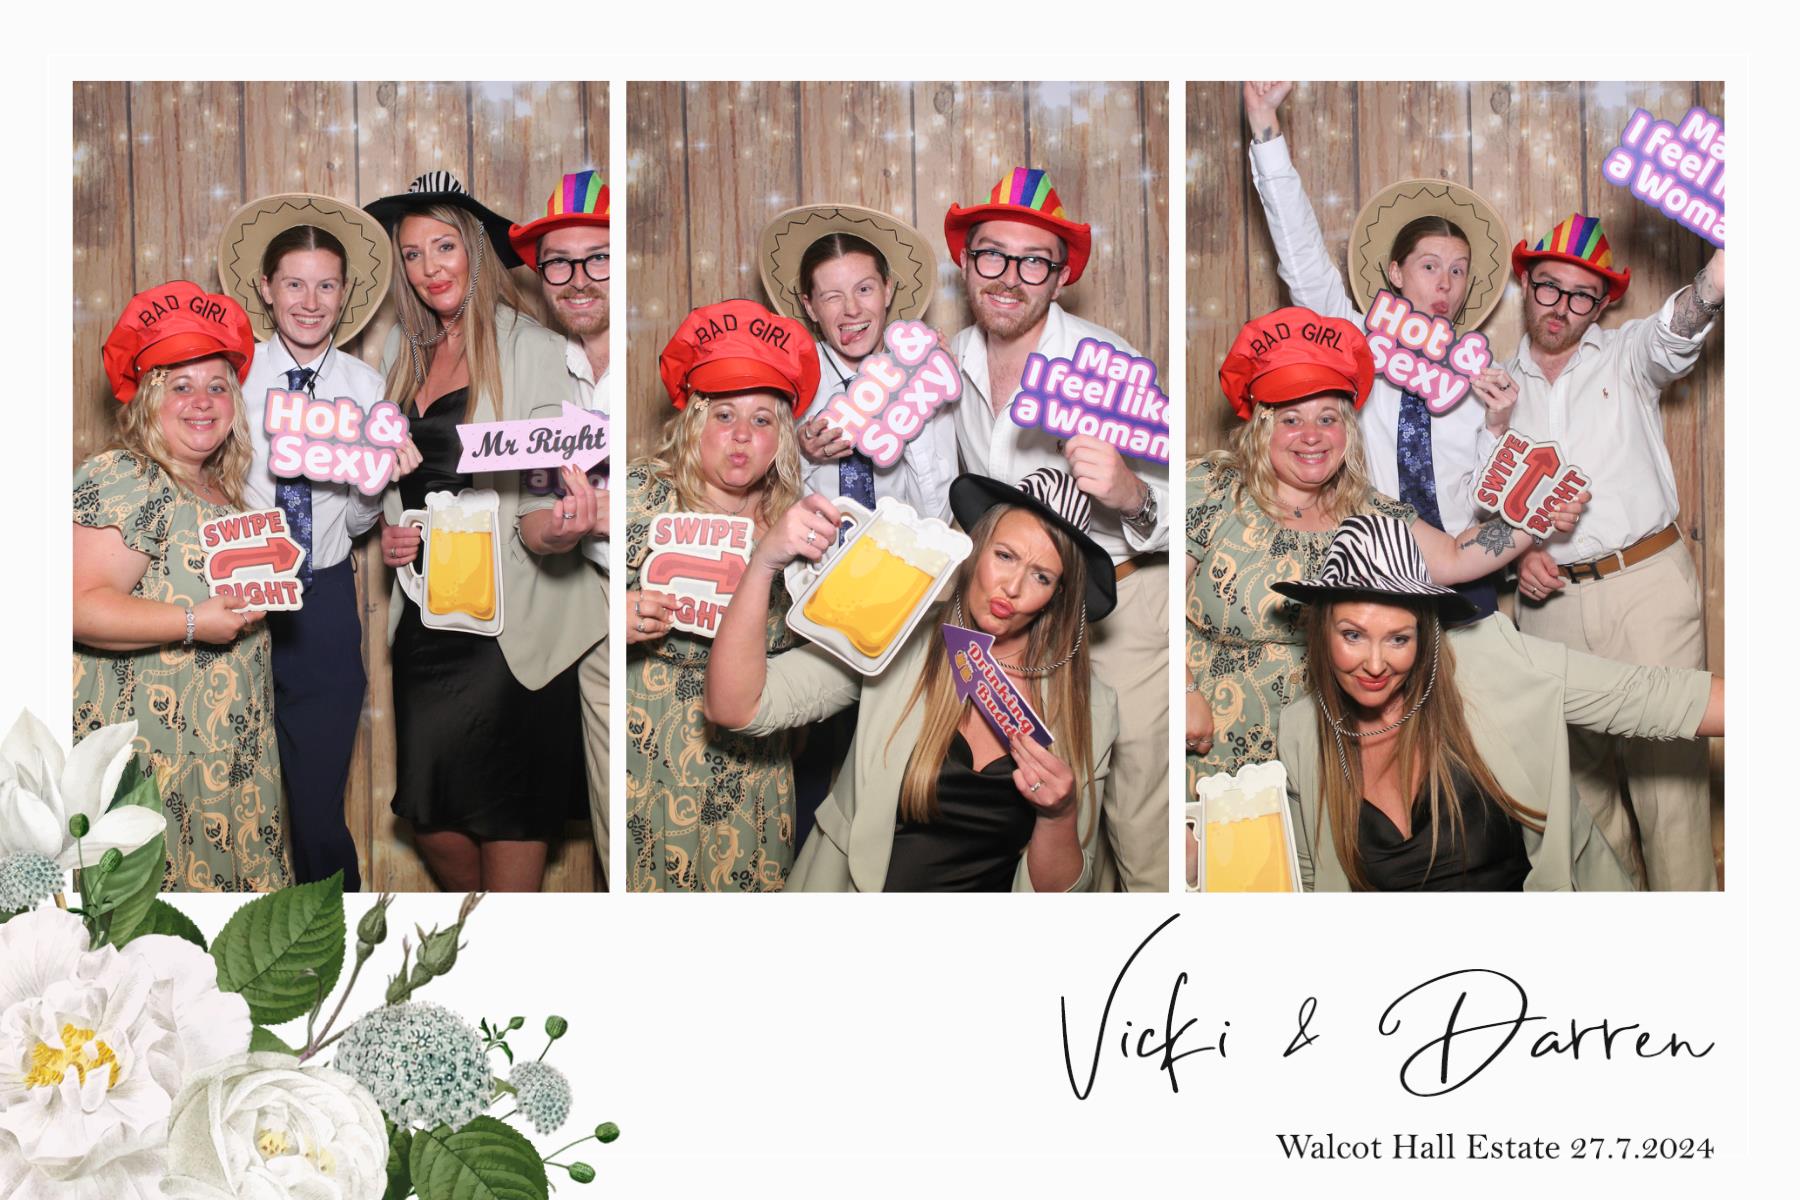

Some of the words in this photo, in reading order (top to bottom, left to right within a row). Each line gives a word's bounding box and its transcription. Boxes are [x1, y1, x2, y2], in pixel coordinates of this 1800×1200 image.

[1629, 116, 1647, 144] I
[1645, 127, 1716, 187] feel
[1681, 114, 1725, 160] Ma
[1608, 153, 1633, 179] a
[1636, 163, 1725, 242] Woma
[138, 294, 180, 328] BAD
[189, 296, 229, 328] GIRL
[694, 313, 738, 345] BAD
[749, 318, 791, 354] GIRL
[1370, 296, 1449, 356] Hot
[1453, 337, 1486, 375] &
[1250, 322, 1291, 357] BAD
[1301, 322, 1344, 353] GIRL
[825, 361, 902, 442] Hot
[891, 326, 932, 361] &
[1027, 360, 1042, 387] I
[1046, 364, 1117, 408] feel
[1077, 344, 1151, 387] Man
[1369, 335, 1465, 408] Sexy
[270, 394, 358, 438] Hot
[369, 407, 403, 443] &
[862, 355, 957, 462] Sexy
[1016, 397, 1039, 421] a
[274, 435, 392, 489] Sexy
[472, 430, 519, 458] Mr
[526, 424, 606, 460] Right
[1477, 433, 1529, 507] SWIPE
[203, 511, 285, 548] SWIPE
[654, 517, 748, 549] SWIPE
[968, 641, 1034, 735] Drinking
[976, 681, 1023, 738] Budd
